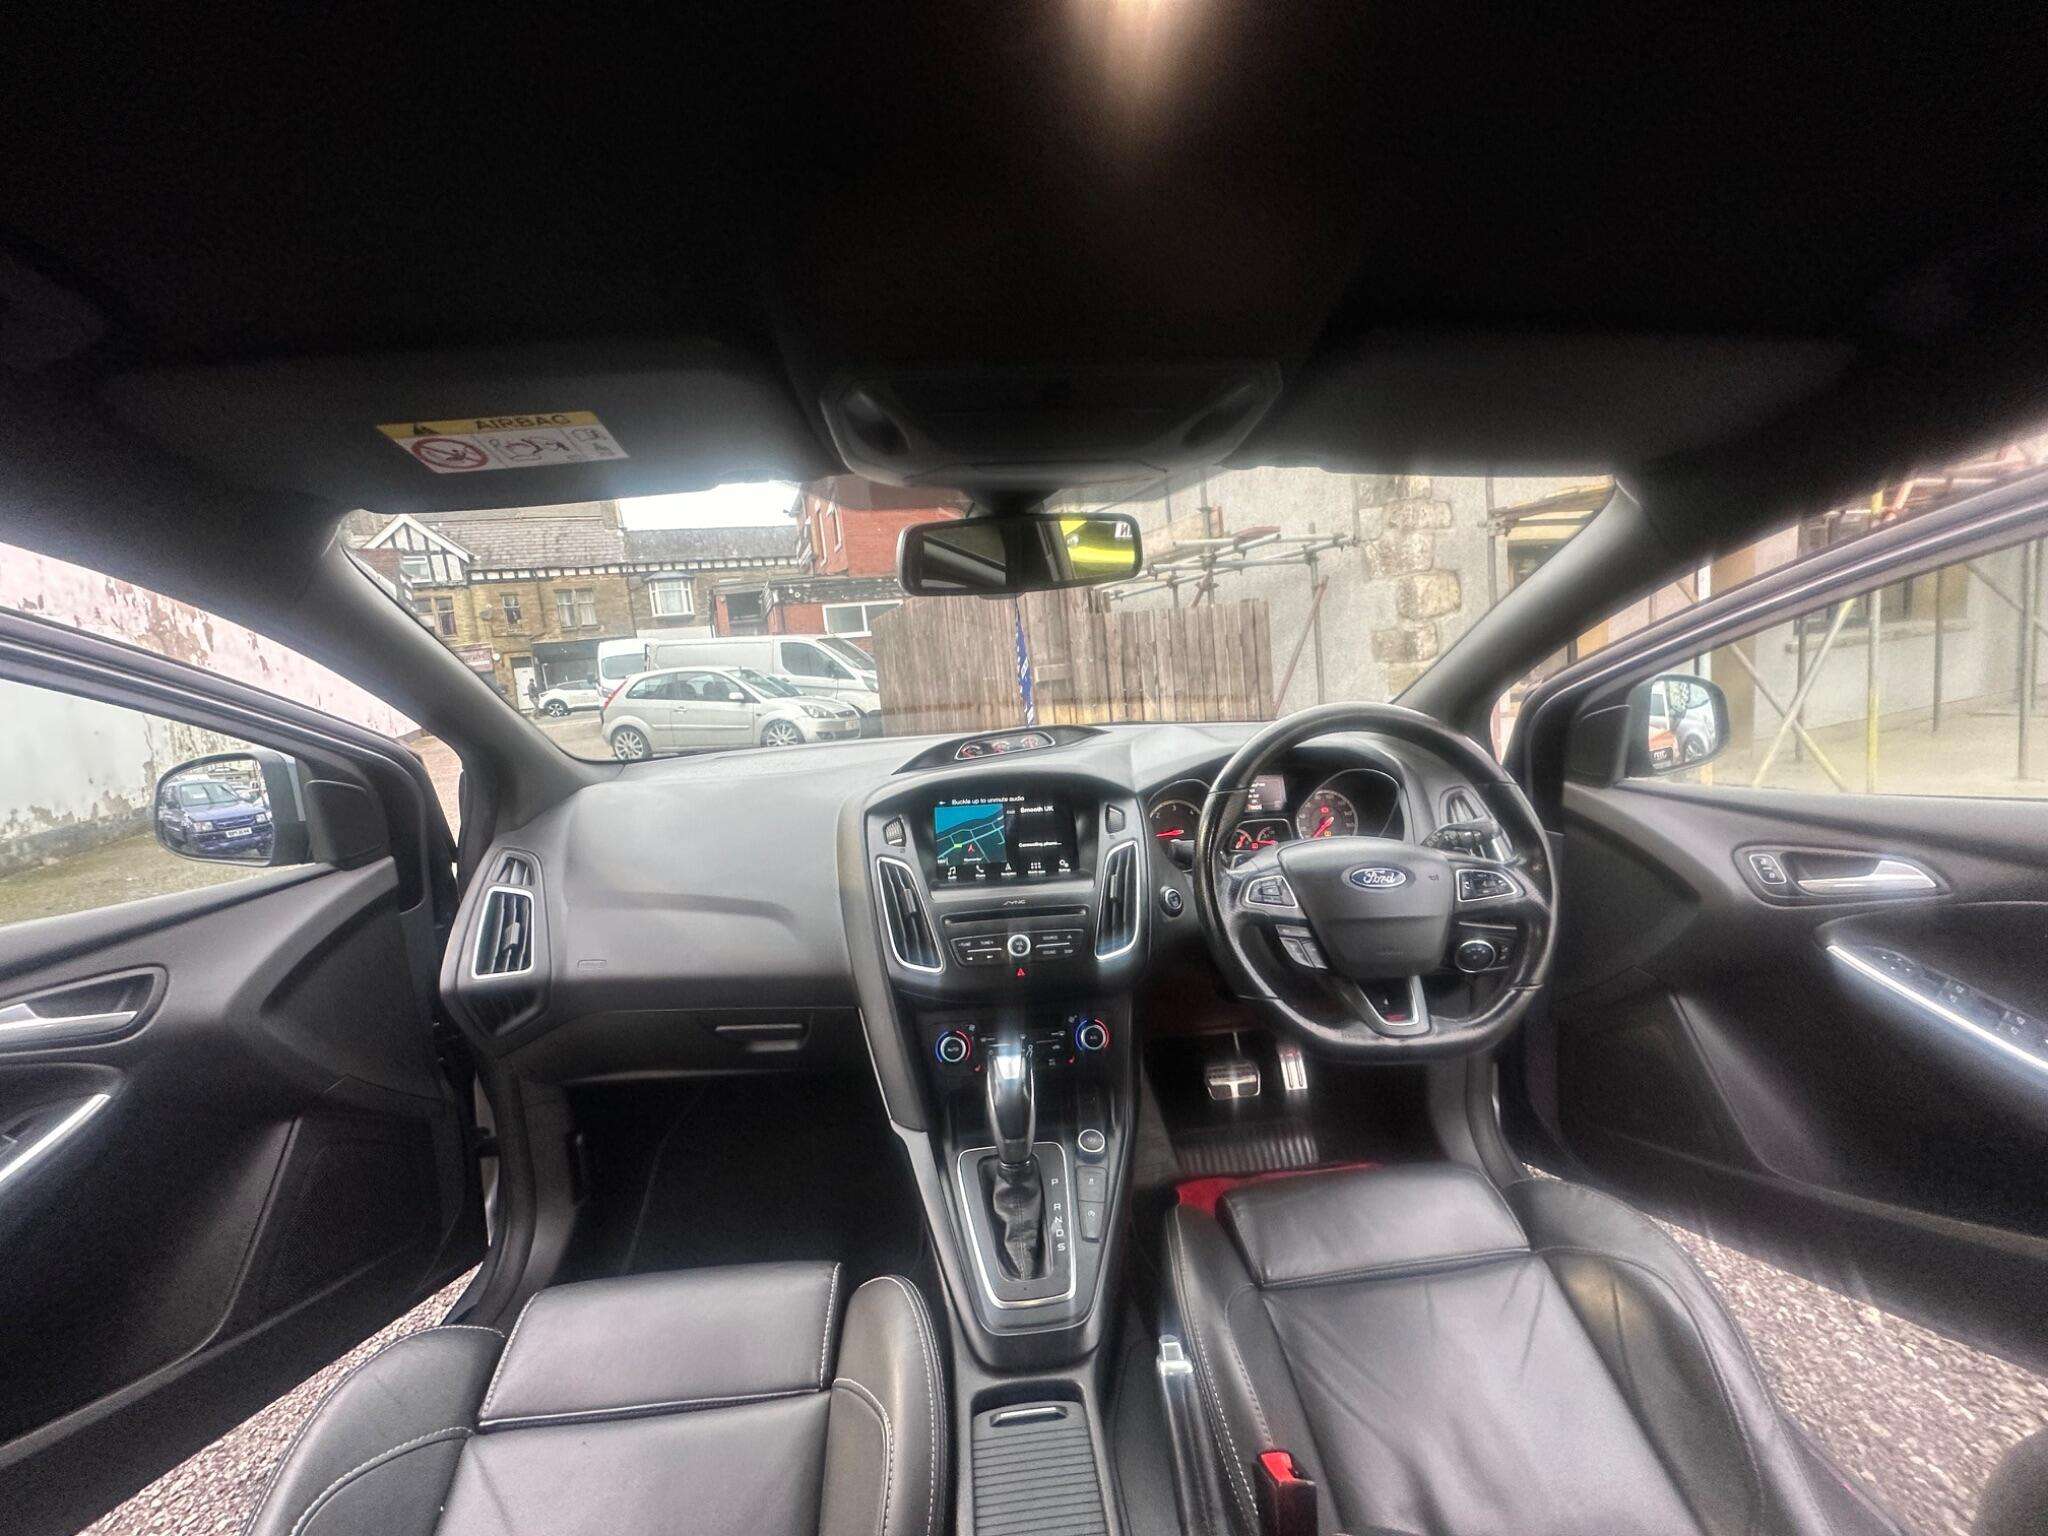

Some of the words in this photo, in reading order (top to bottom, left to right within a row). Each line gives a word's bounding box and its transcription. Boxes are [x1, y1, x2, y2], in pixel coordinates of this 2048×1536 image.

[476, 414, 571, 431] AIRBAG
[1363, 870, 1396, 884] Ford
[1051, 1178, 1059, 1187] P
[1053, 1203, 1062, 1211] R
[1056, 1229, 1064, 1237] D
[1057, 1242, 1066, 1252] S
